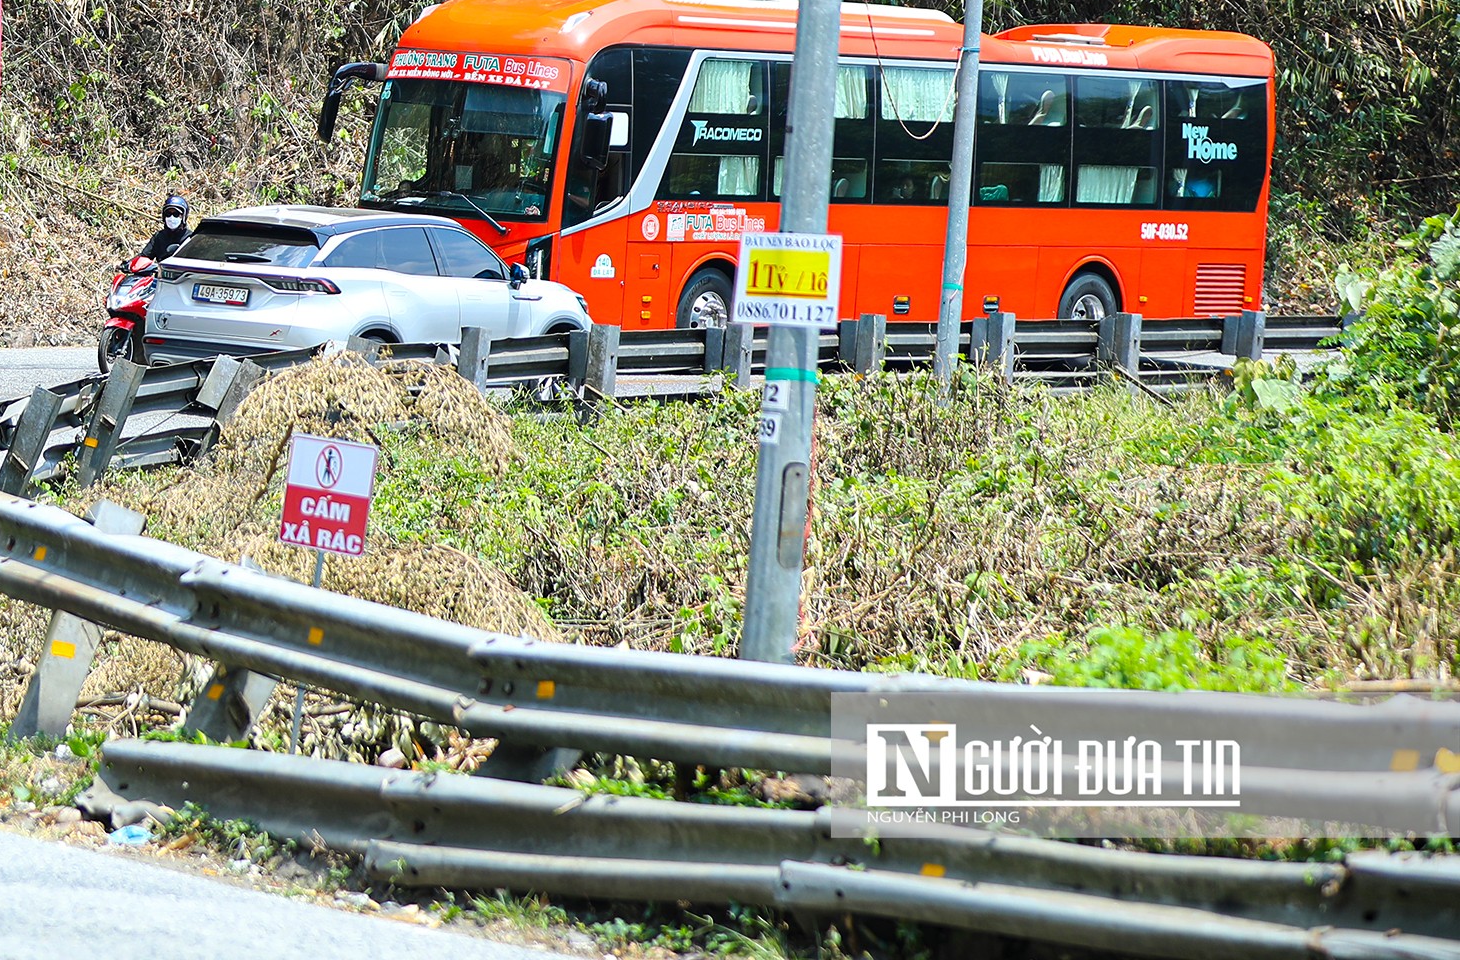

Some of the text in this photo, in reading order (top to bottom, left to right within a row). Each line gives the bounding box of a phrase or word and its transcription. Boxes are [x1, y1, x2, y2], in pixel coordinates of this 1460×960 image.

[425, 52, 458, 68] TRANG
[463, 54, 500, 72] FUTA
[504, 58, 526, 75] Bus
[527, 61, 558, 80] Lines
[463, 70, 486, 82] BẾN
[487, 74, 504, 84] XE
[524, 78, 551, 90] LẠT
[690, 120, 763, 147] TRACOMECO
[1182, 123, 1209, 140] New
[1188, 137, 1238, 162] Home
[685, 214, 714, 231] FUTA
[716, 214, 737, 232] Bus
[738, 214, 765, 232] Lines
[1140, 223, 1189, 240] 50F-030.52
[598, 257, 610, 267] 140
[749, 258, 759, 288] 1
[796, 271, 805, 290] /
[811, 271, 828, 291] lô
[737, 301, 835, 323] 0886.701.127
[300, 495, 351, 524] CẤM
[282, 519, 363, 554] XẢ RÁC
